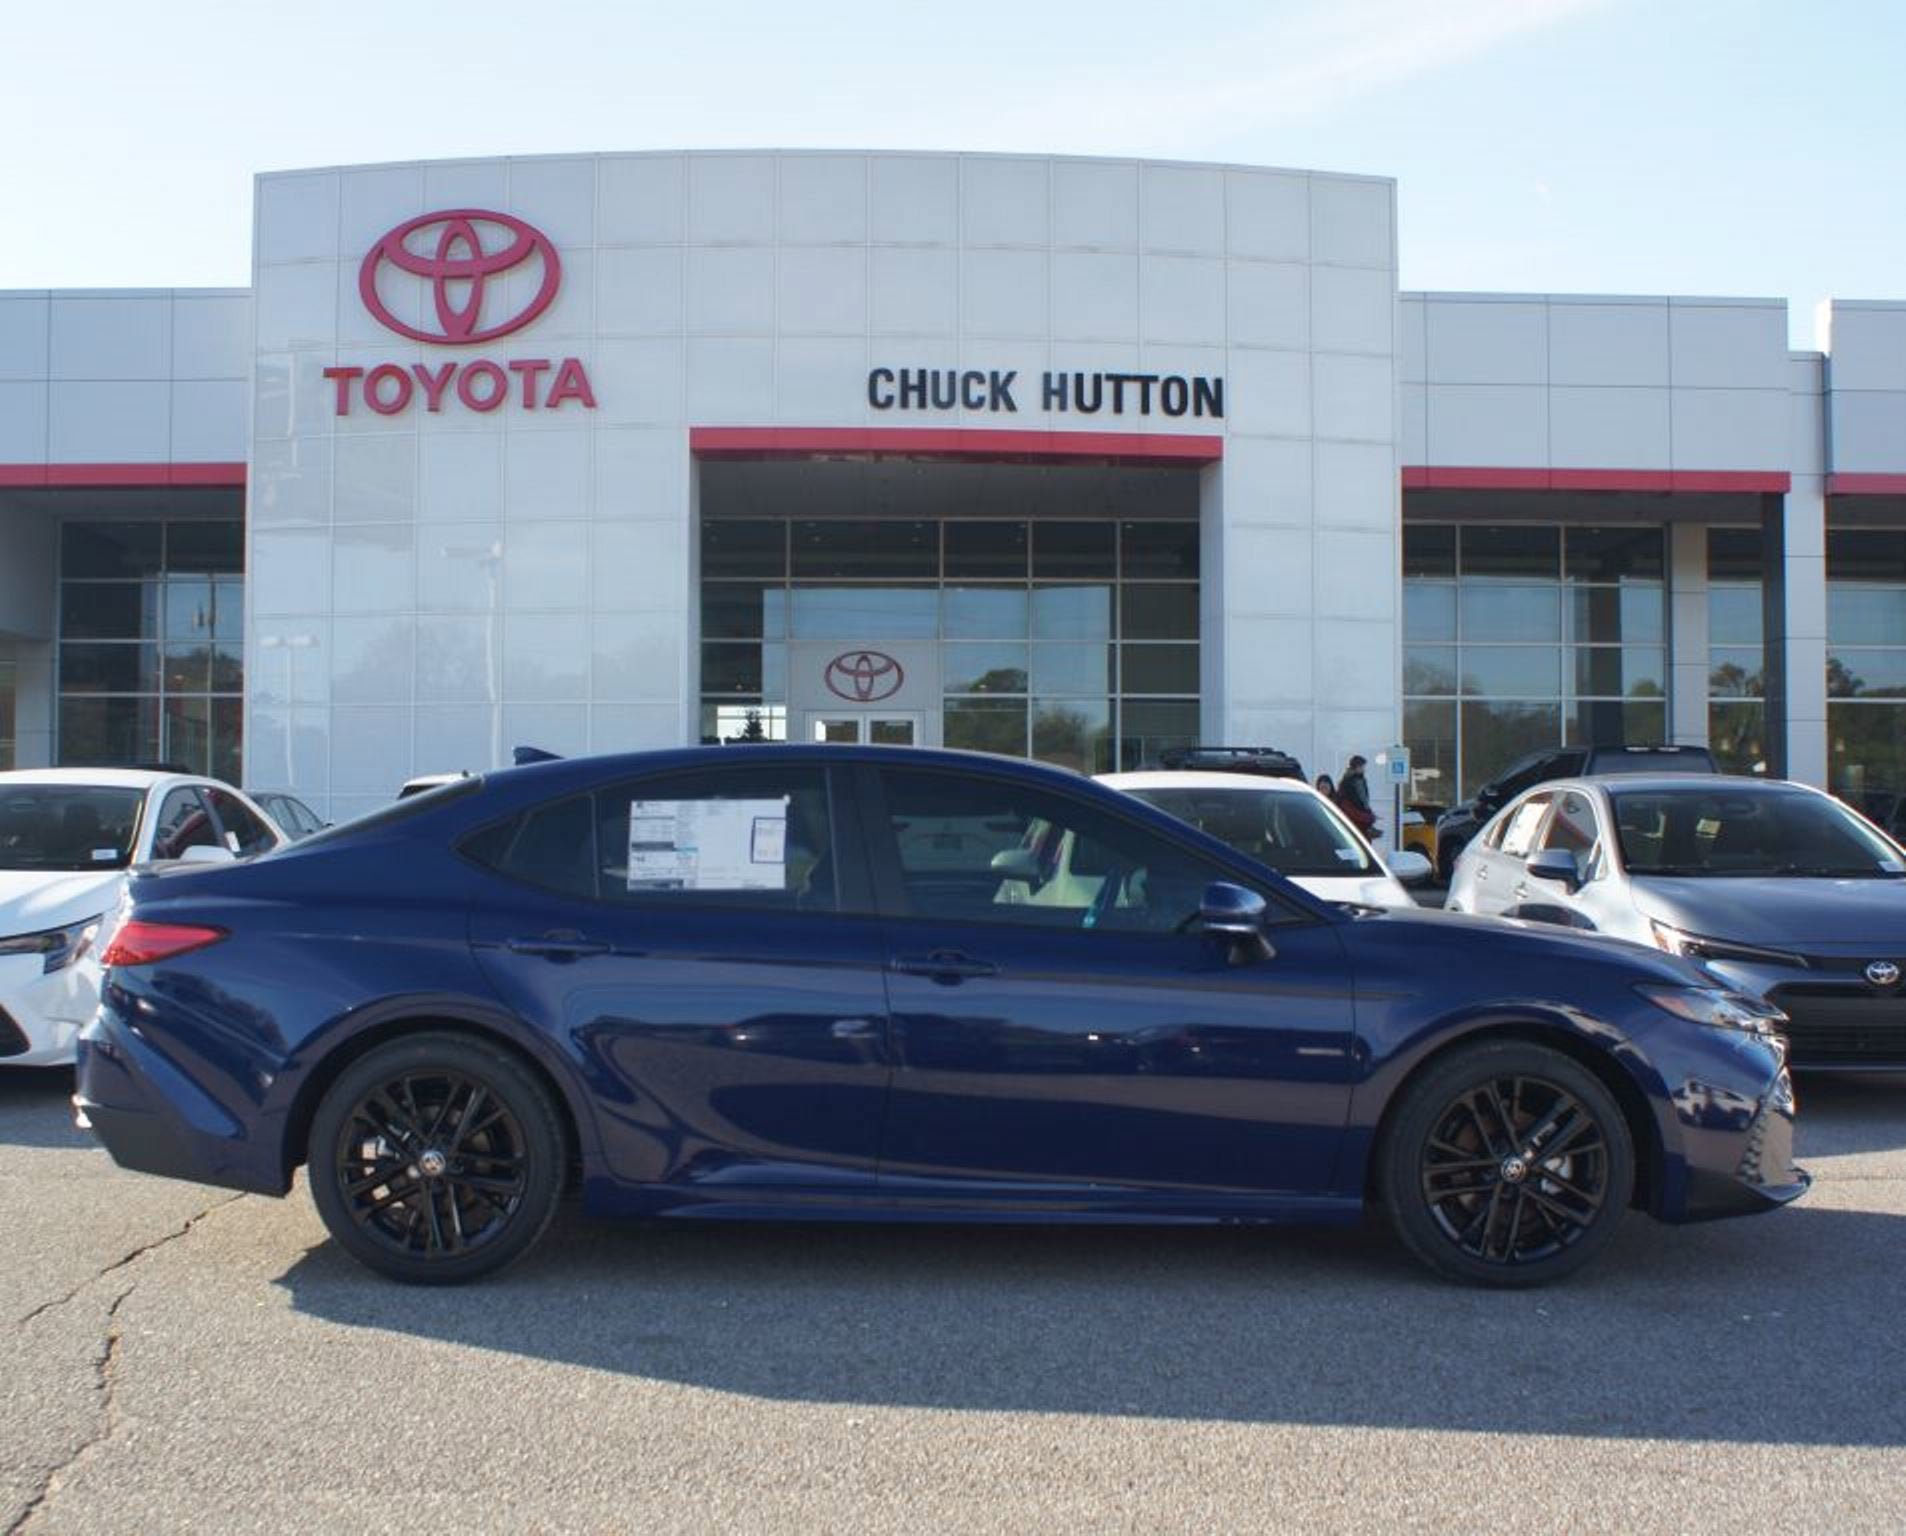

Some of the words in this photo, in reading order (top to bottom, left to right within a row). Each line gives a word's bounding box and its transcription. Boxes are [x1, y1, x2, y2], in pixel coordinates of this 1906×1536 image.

[323, 358, 597, 416] TOYOTA
[868, 368, 1018, 412] CHUCK
[1042, 372, 1224, 418] HUTTON
